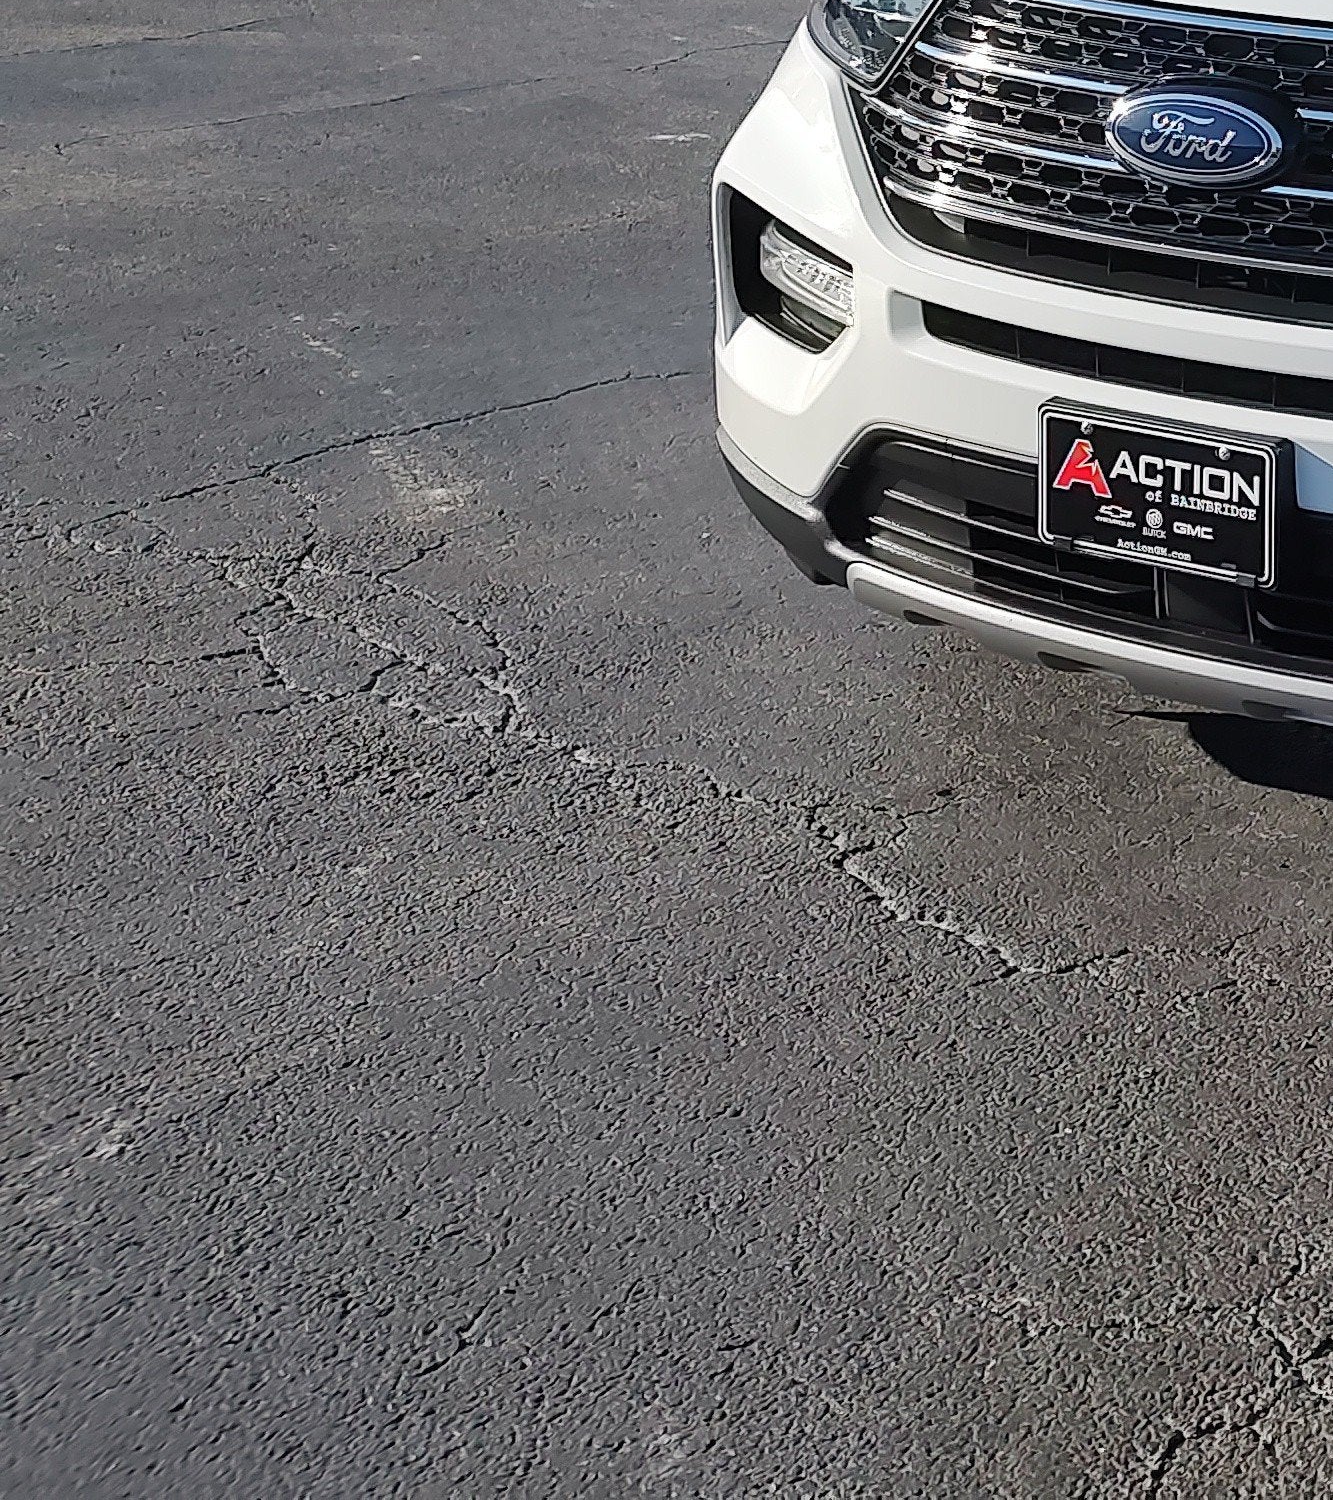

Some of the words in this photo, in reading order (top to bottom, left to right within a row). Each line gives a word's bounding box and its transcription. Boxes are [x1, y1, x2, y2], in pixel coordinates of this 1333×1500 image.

[1140, 109, 1237, 164] Ford
[1109, 450, 1261, 507] ACTION
[1145, 489, 1163, 503] of
[1170, 493, 1257, 521] BAINBRIDGE
[1173, 521, 1215, 540] GMC
[1116, 538, 1192, 562] ActionGM.com
